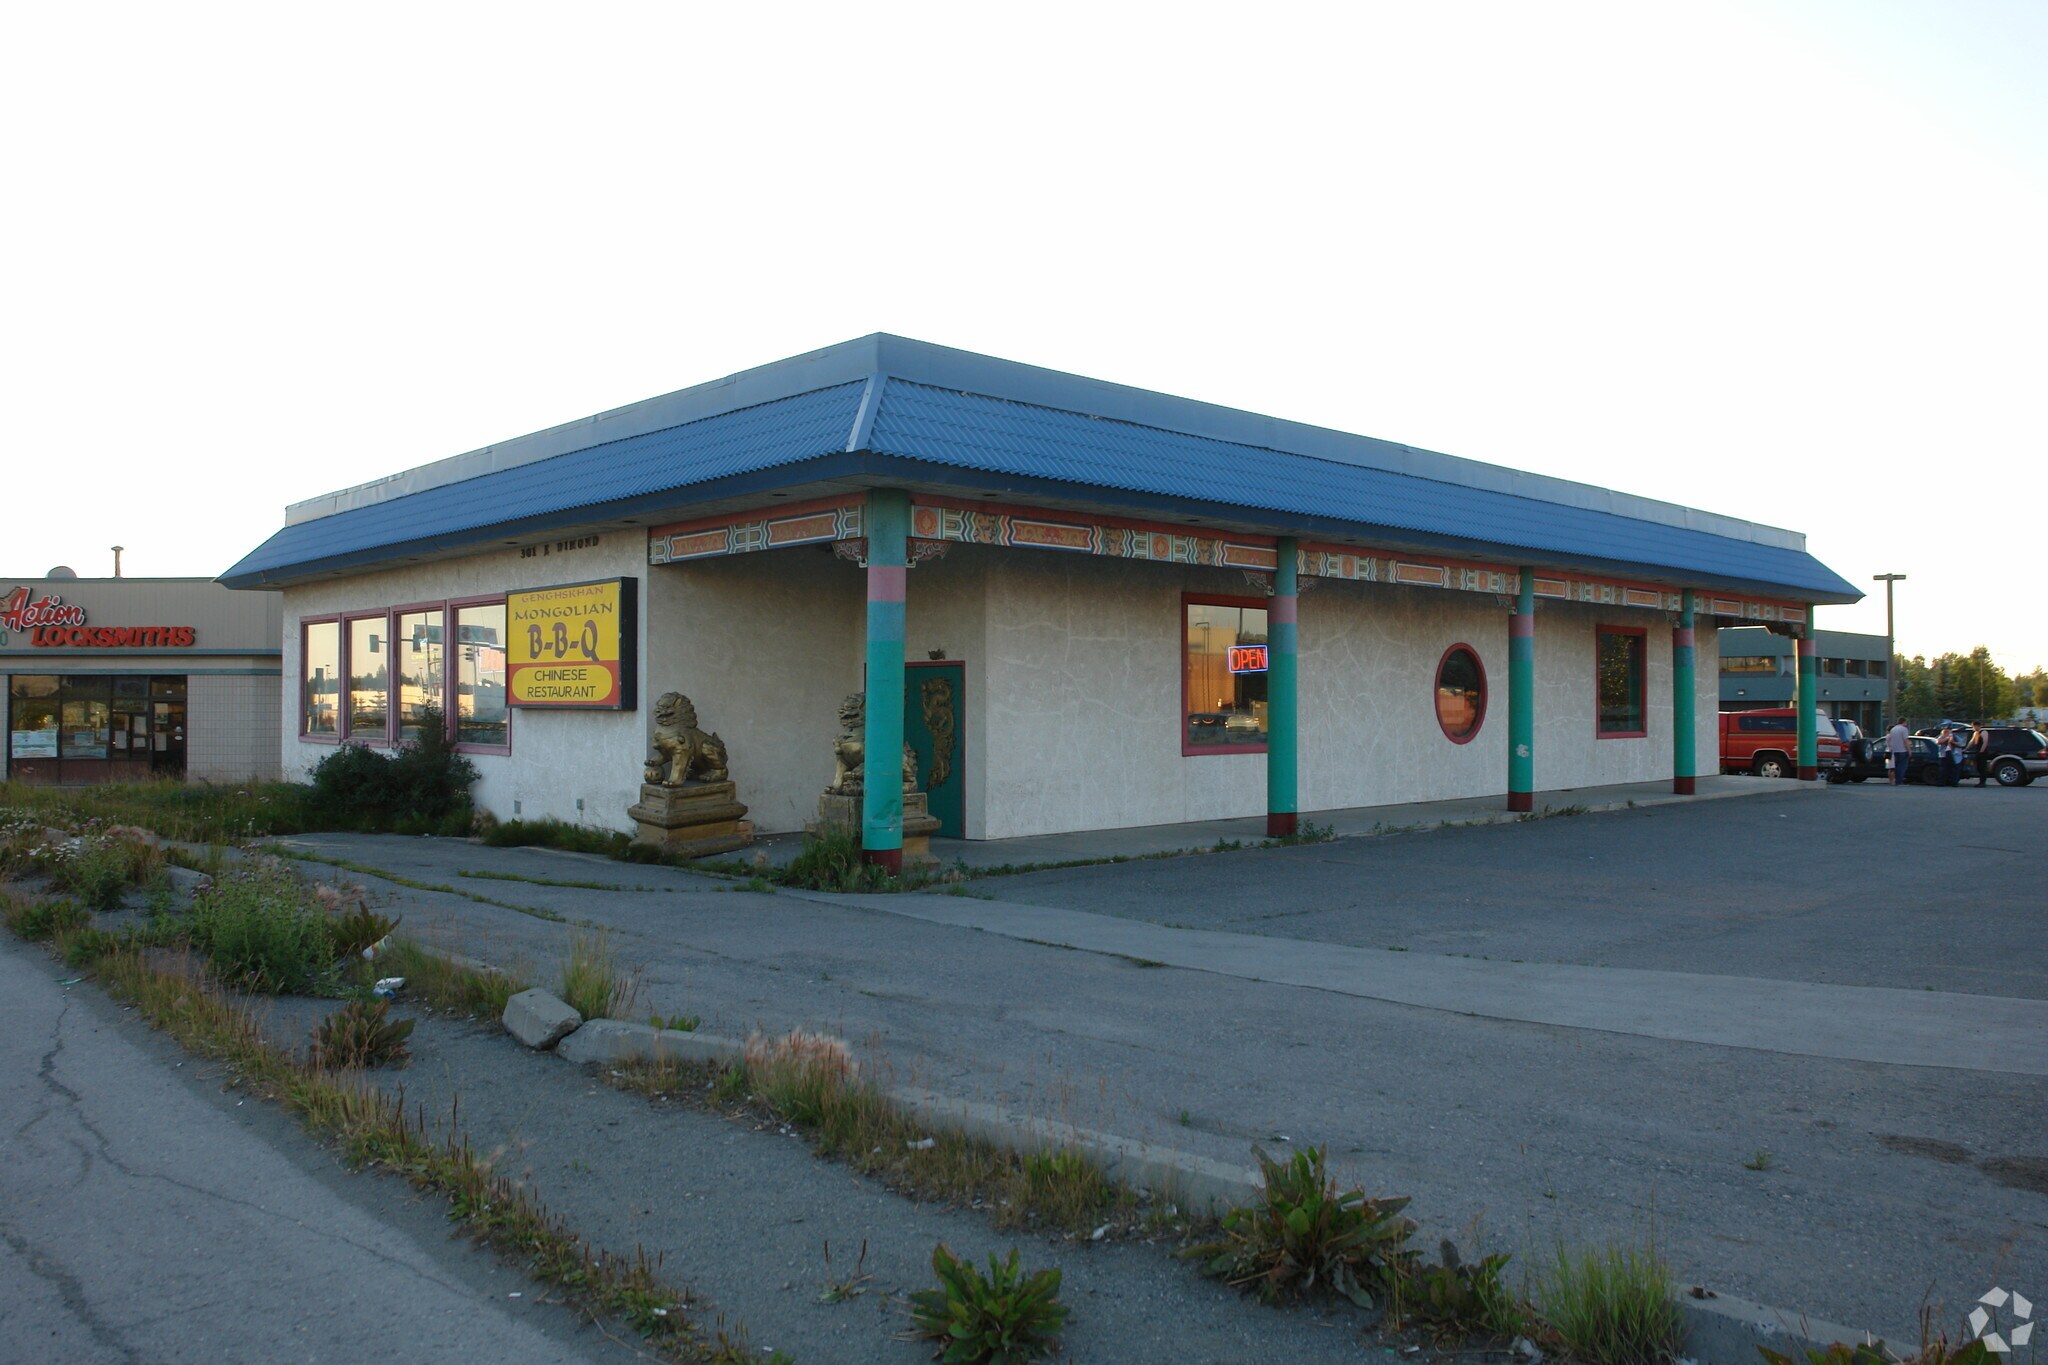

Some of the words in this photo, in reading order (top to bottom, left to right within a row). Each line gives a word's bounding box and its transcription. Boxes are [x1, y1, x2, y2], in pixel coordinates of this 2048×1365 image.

[1, 587, 84, 632] Action
[515, 602, 613, 621] MONGOLIAN
[31, 626, 196, 648] LOCKSMITHS
[527, 619, 600, 662] B-B-Q
[1231, 649, 1266, 671] OPEN
[534, 669, 588, 682] CHINESE
[527, 685, 597, 698] RESTAURANT
